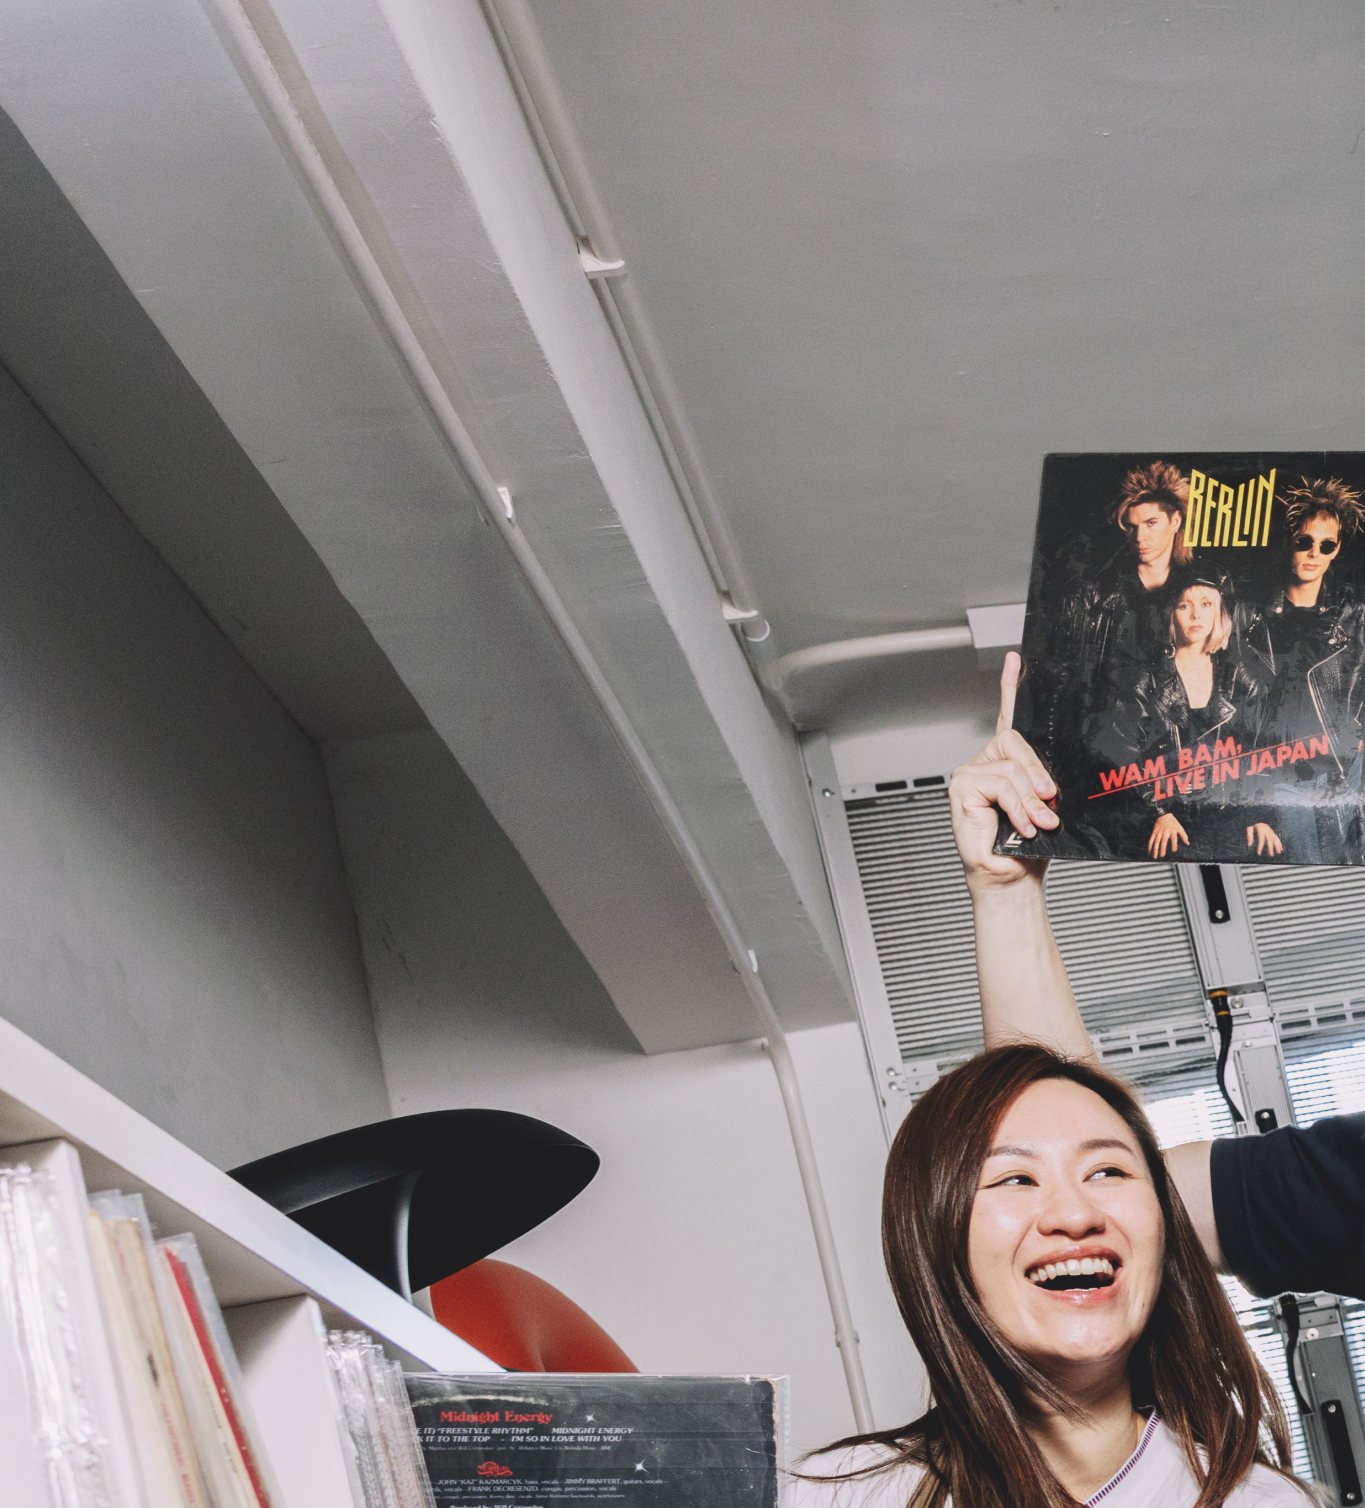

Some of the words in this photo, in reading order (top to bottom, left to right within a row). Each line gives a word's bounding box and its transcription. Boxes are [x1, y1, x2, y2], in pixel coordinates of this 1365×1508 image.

[1183, 468, 1277, 547] BERLIN
[1099, 759, 1166, 791] WAM
[1178, 735, 1242, 767] BAM,
[1153, 770, 1206, 801] LIVE
[1212, 760, 1239, 785] IN
[1246, 735, 1329, 776] JAPAN
[440, 1411, 500, 1424] Midnight
[505, 1411, 554, 1424] Energy
